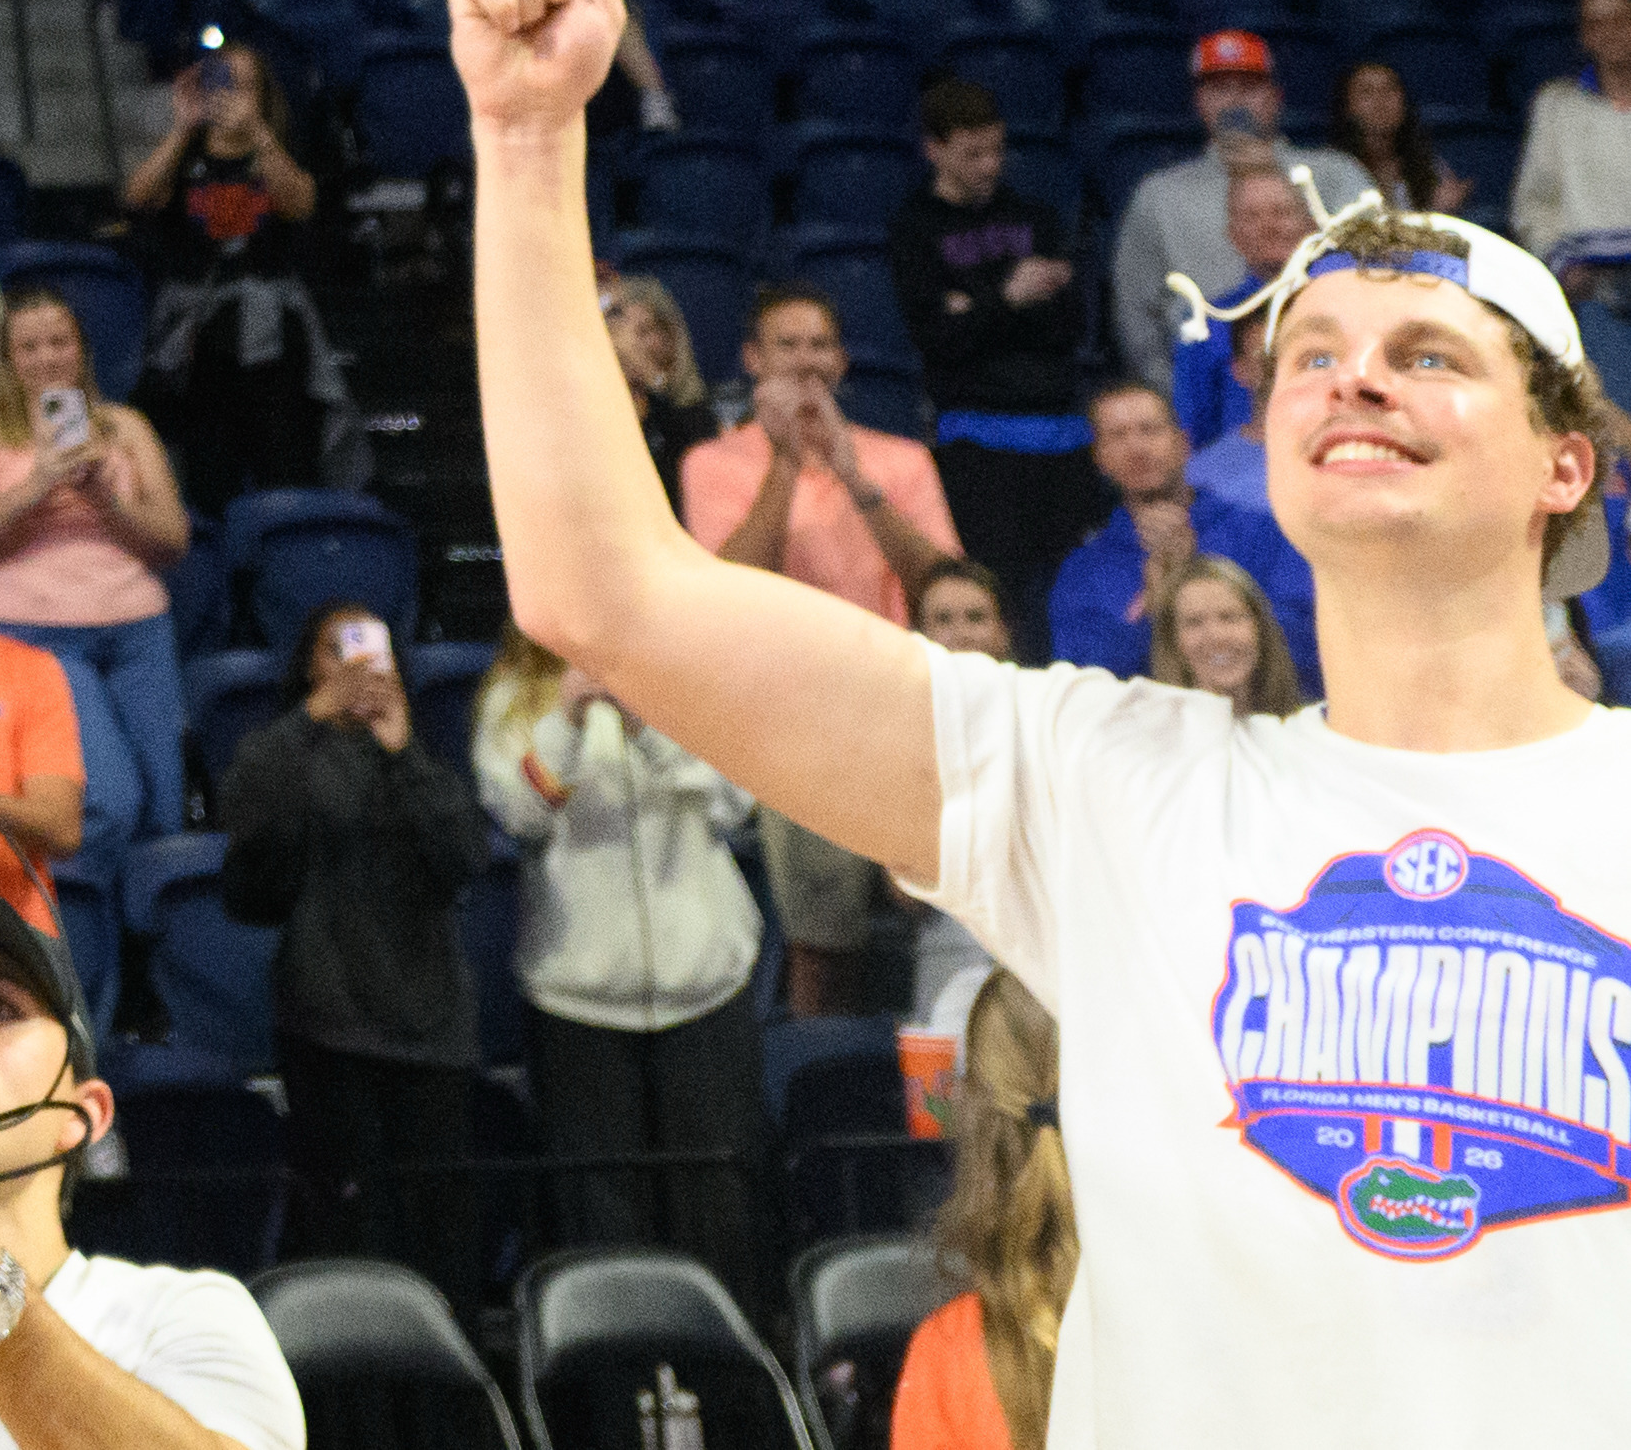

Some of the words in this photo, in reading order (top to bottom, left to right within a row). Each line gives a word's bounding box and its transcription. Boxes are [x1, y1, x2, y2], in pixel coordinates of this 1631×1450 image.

[1392, 840, 1461, 895] SEC
[1438, 924, 1600, 969] CONFERENCE
[1220, 931, 1631, 1145] CHAMPIONS
[1260, 1087, 1350, 1107] FLORIDA
[1352, 1090, 1421, 1113] MEN'S
[1423, 1094, 1575, 1147] BASKETBALL
[1315, 1125, 1355, 1148] 20
[1463, 1147, 1505, 1171] 26
